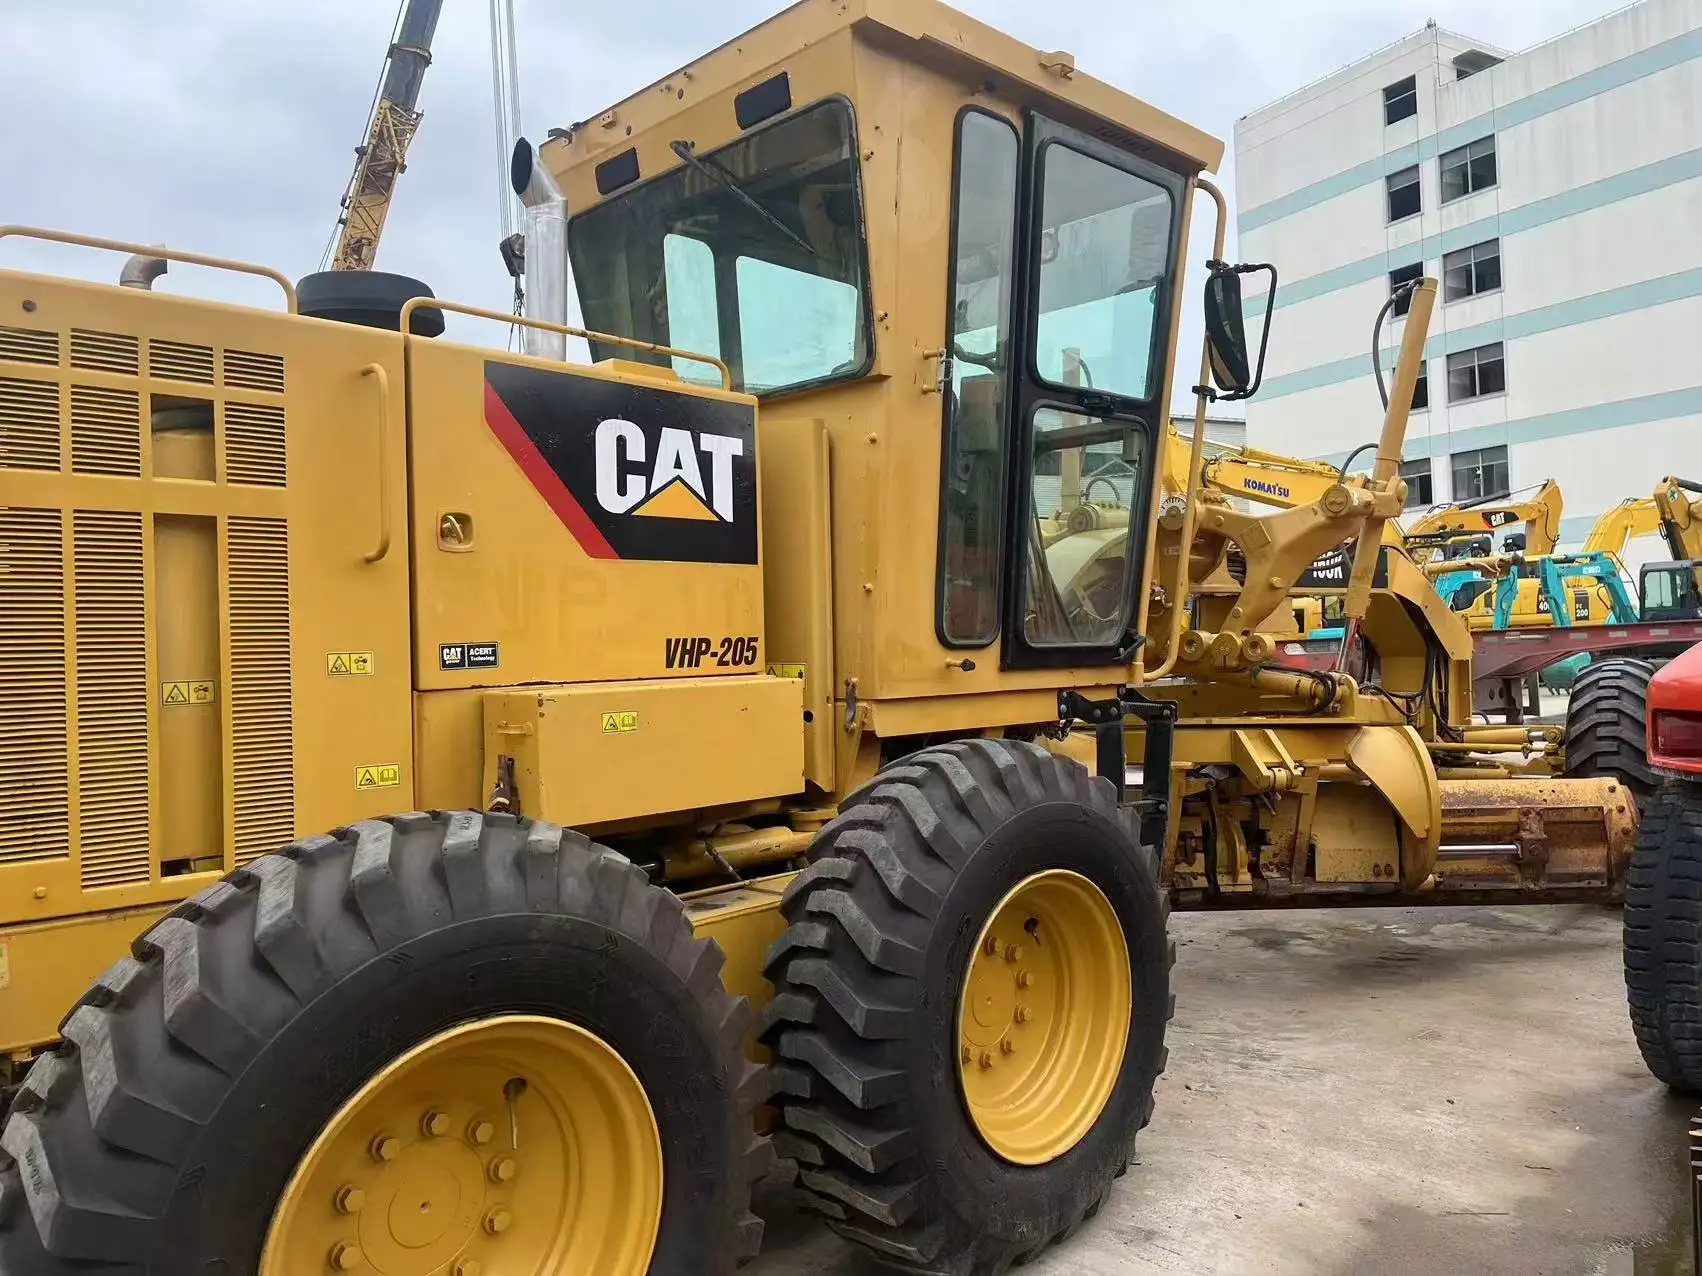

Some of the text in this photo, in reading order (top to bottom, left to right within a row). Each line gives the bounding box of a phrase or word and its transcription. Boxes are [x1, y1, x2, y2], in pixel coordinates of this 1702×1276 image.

[595, 418, 744, 523] CAT
[1243, 478, 1290, 498] KOMATSU
[1490, 511, 1505, 527] CAT
[1575, 608, 1589, 617] 200
[443, 647, 462, 661] CAT
[665, 637, 759, 669] VHP-205
